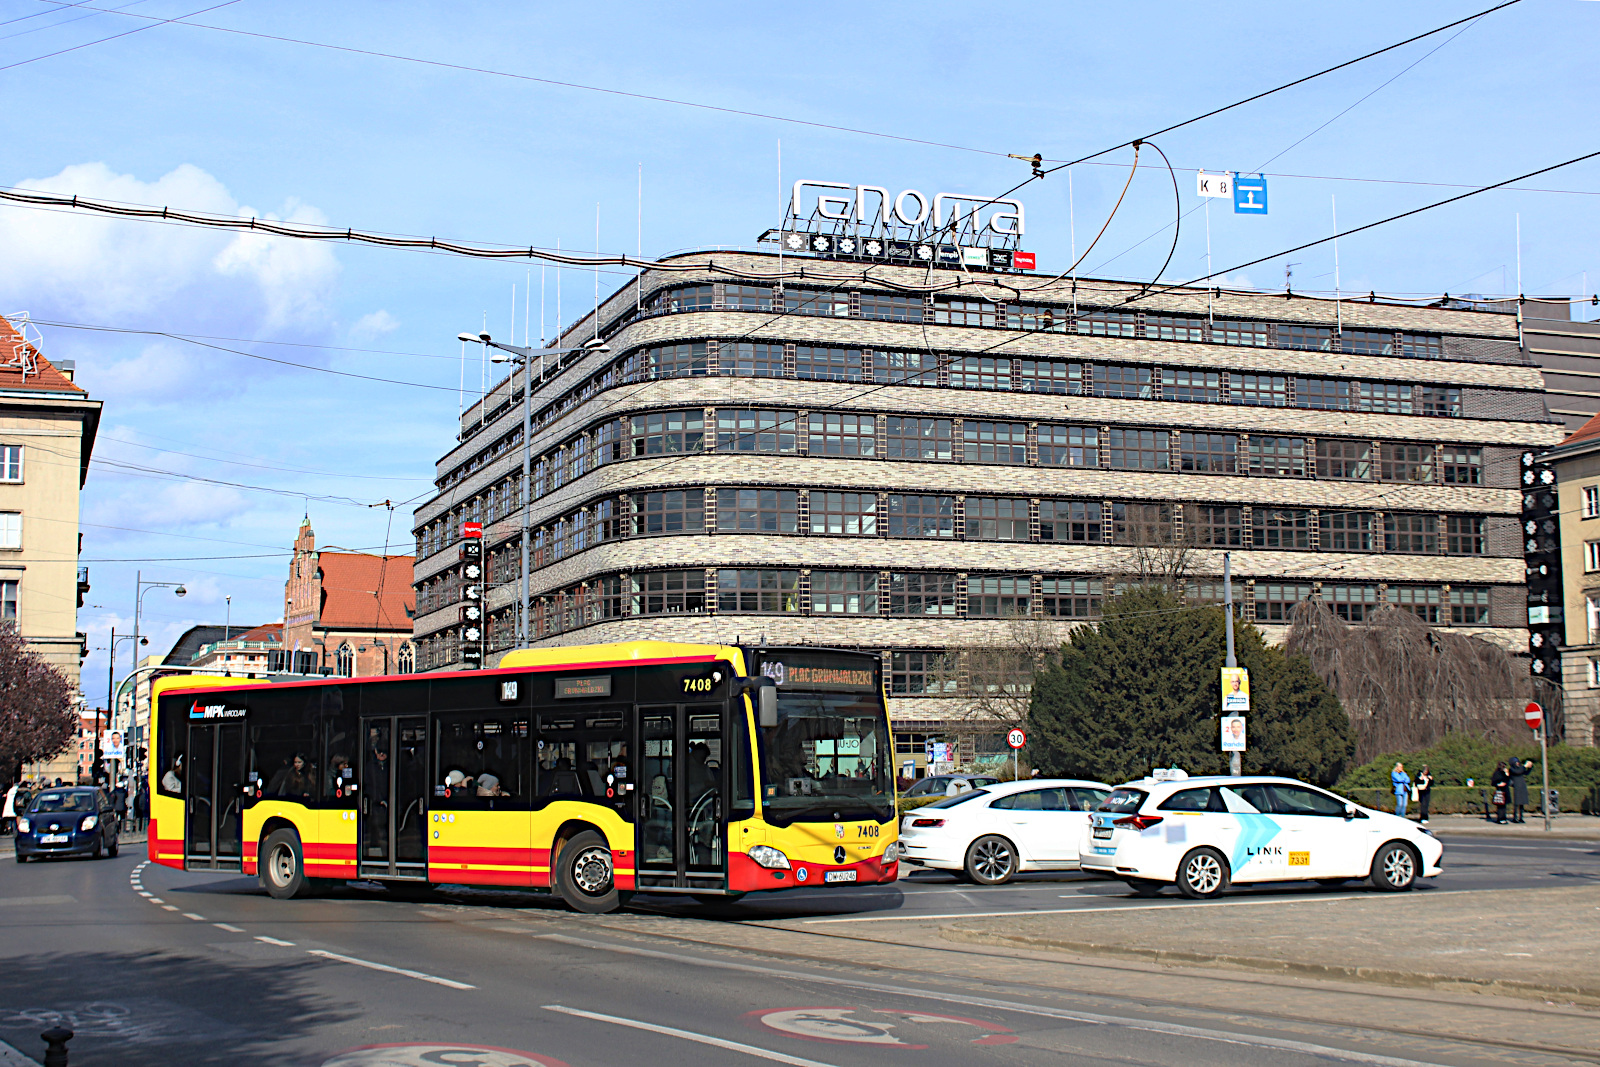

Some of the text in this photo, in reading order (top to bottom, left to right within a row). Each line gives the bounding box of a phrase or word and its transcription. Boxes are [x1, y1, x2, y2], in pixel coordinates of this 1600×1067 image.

[1201, 180, 1227, 193] K 8
[760, 661, 784, 686] 149
[788, 667, 810, 683] PLAC
[501, 681, 518, 700] 149
[683, 678, 712, 692] 7408
[204, 705, 225, 718] MPK
[1010, 734, 1023, 744] 30
[857, 825, 879, 838] 7408
[1247, 846, 1282, 856] LINK
[1291, 857, 1308, 865] 7331
